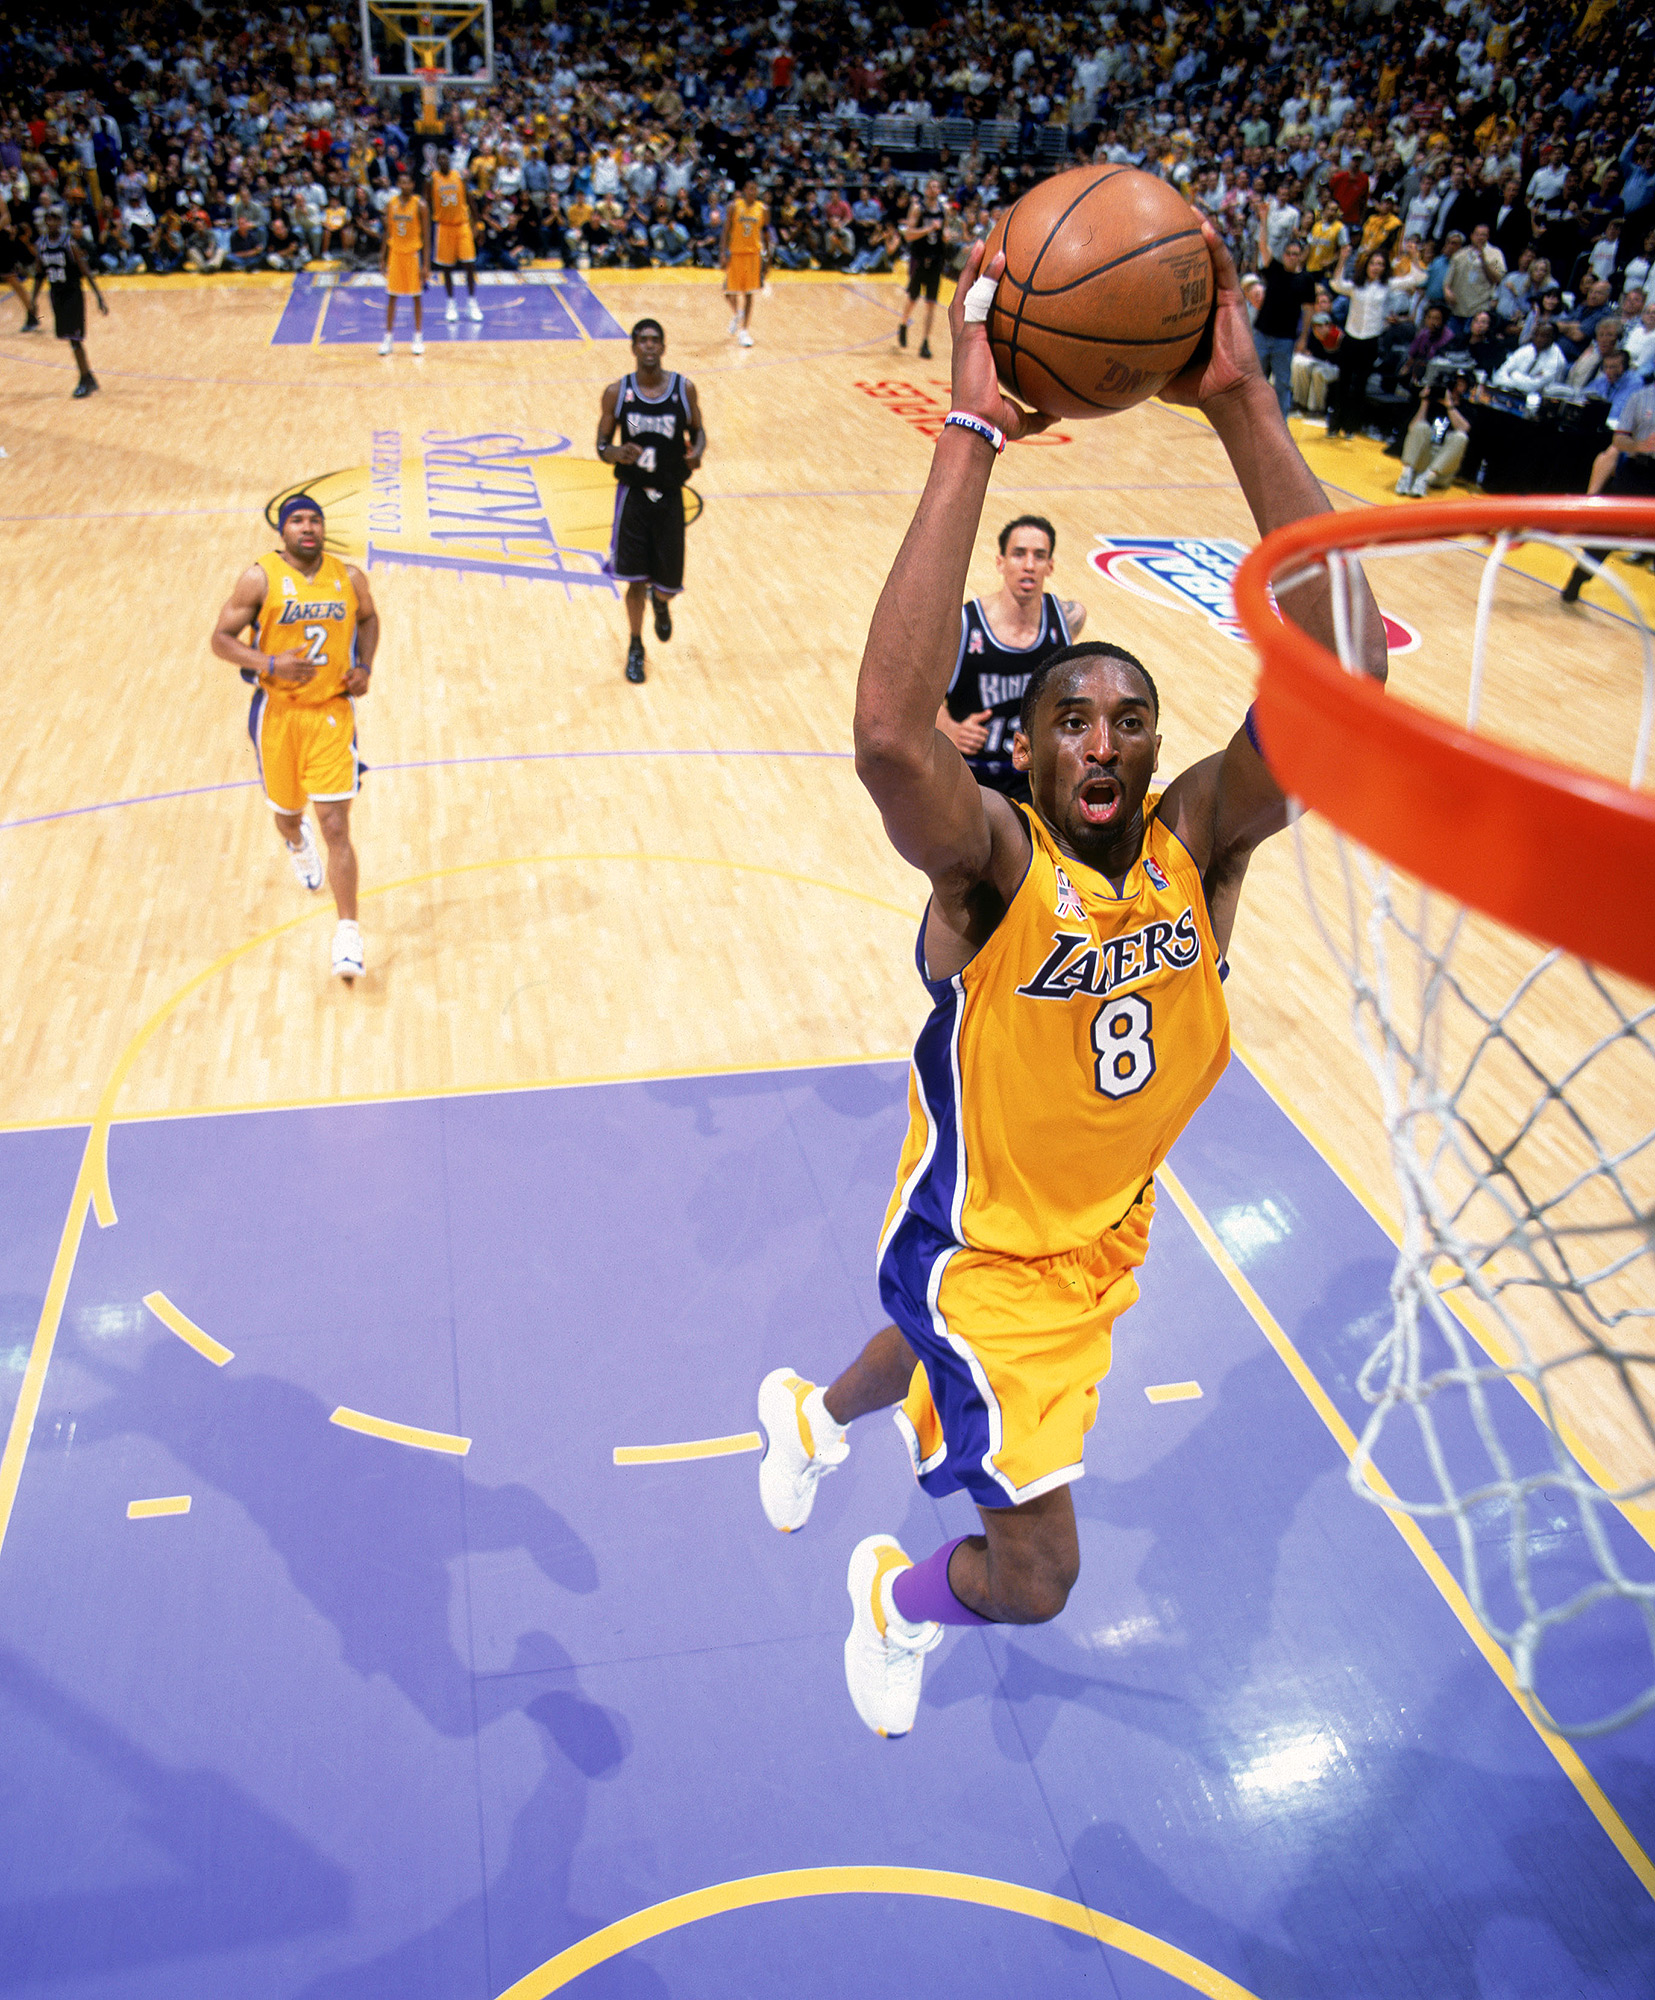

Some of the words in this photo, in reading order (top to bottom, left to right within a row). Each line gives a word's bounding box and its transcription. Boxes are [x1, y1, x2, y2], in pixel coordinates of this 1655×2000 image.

[370, 430, 402, 498] ANGELES
[636, 446, 657, 474] 4
[367, 425, 620, 602] LAKERS
[368, 502, 402, 534] LOS
[277, 598, 346, 625] LAKERS
[304, 623, 329, 667] 2
[979, 673, 1032, 709] KIN
[1090, 991, 1157, 1101] 8
